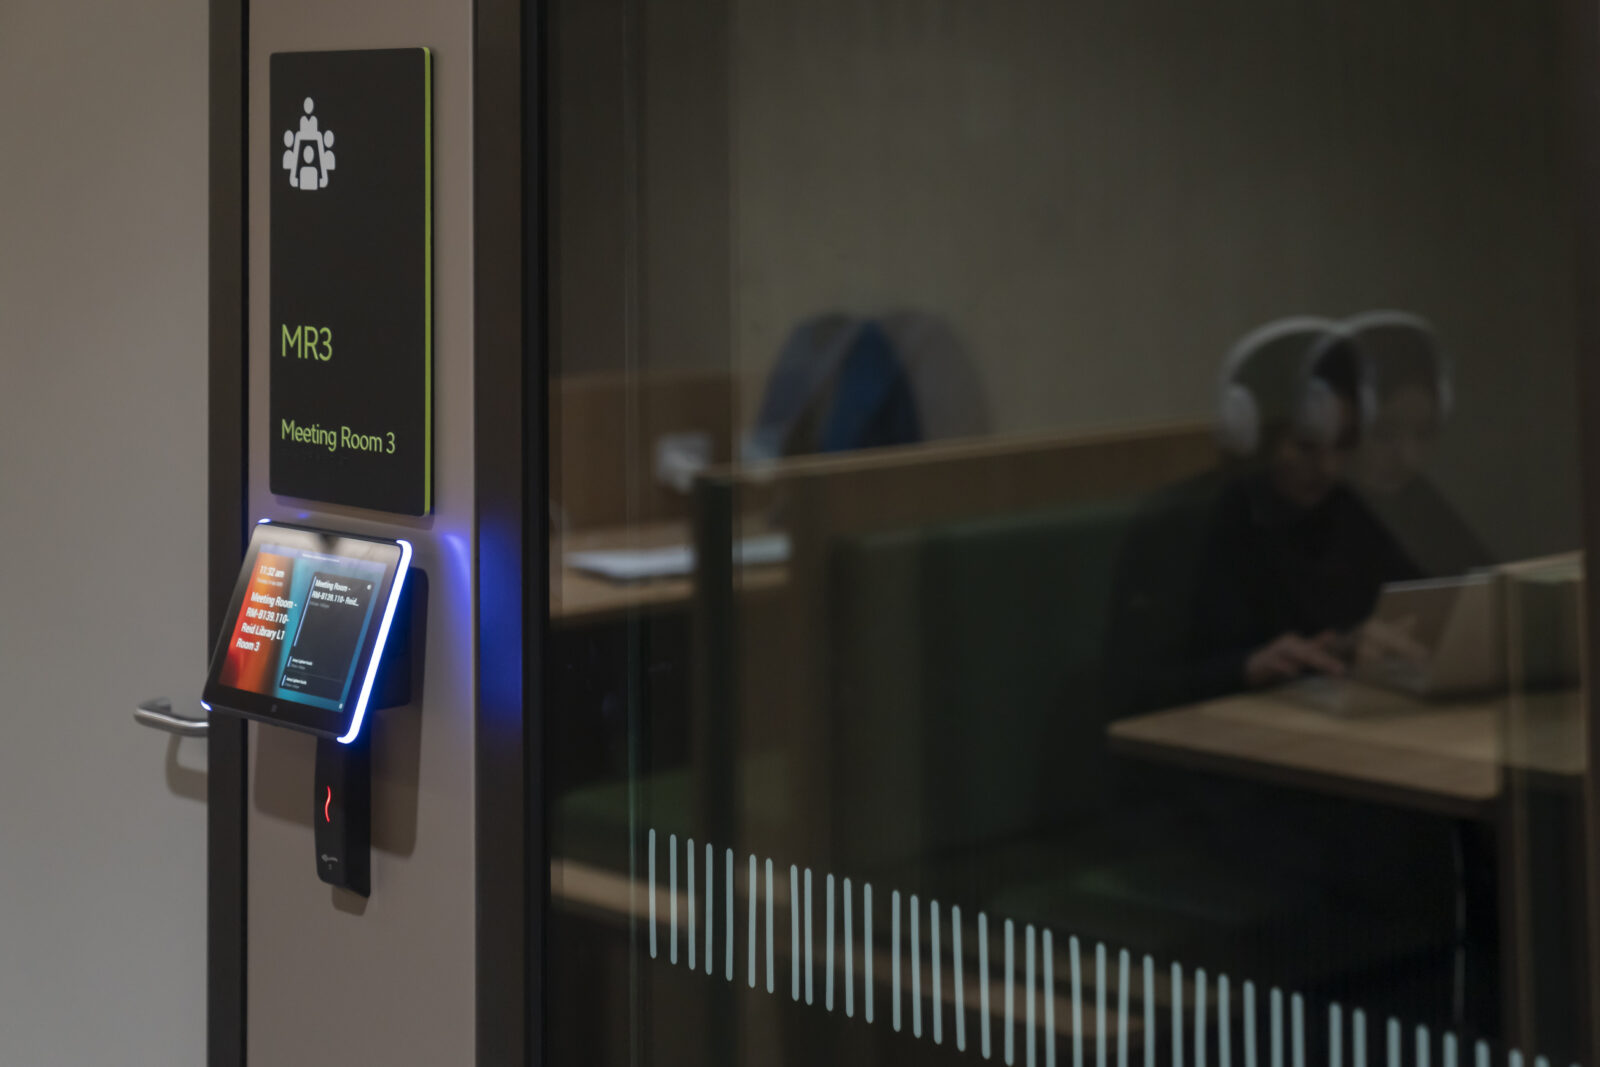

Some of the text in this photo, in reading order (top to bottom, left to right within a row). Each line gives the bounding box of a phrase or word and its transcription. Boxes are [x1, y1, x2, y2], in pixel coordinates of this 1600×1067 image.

[281, 323, 333, 361] MR3
[281, 418, 396, 454] Meeting Room 3
[315, 579, 334, 591] Meeting
[334, 582, 348, 592] Room
[250, 591, 275, 608] Meeting
[275, 596, 294, 608] Room
[241, 622, 256, 634] Reid
[255, 625, 277, 641] Library
[235, 637, 260, 652] Room 3
